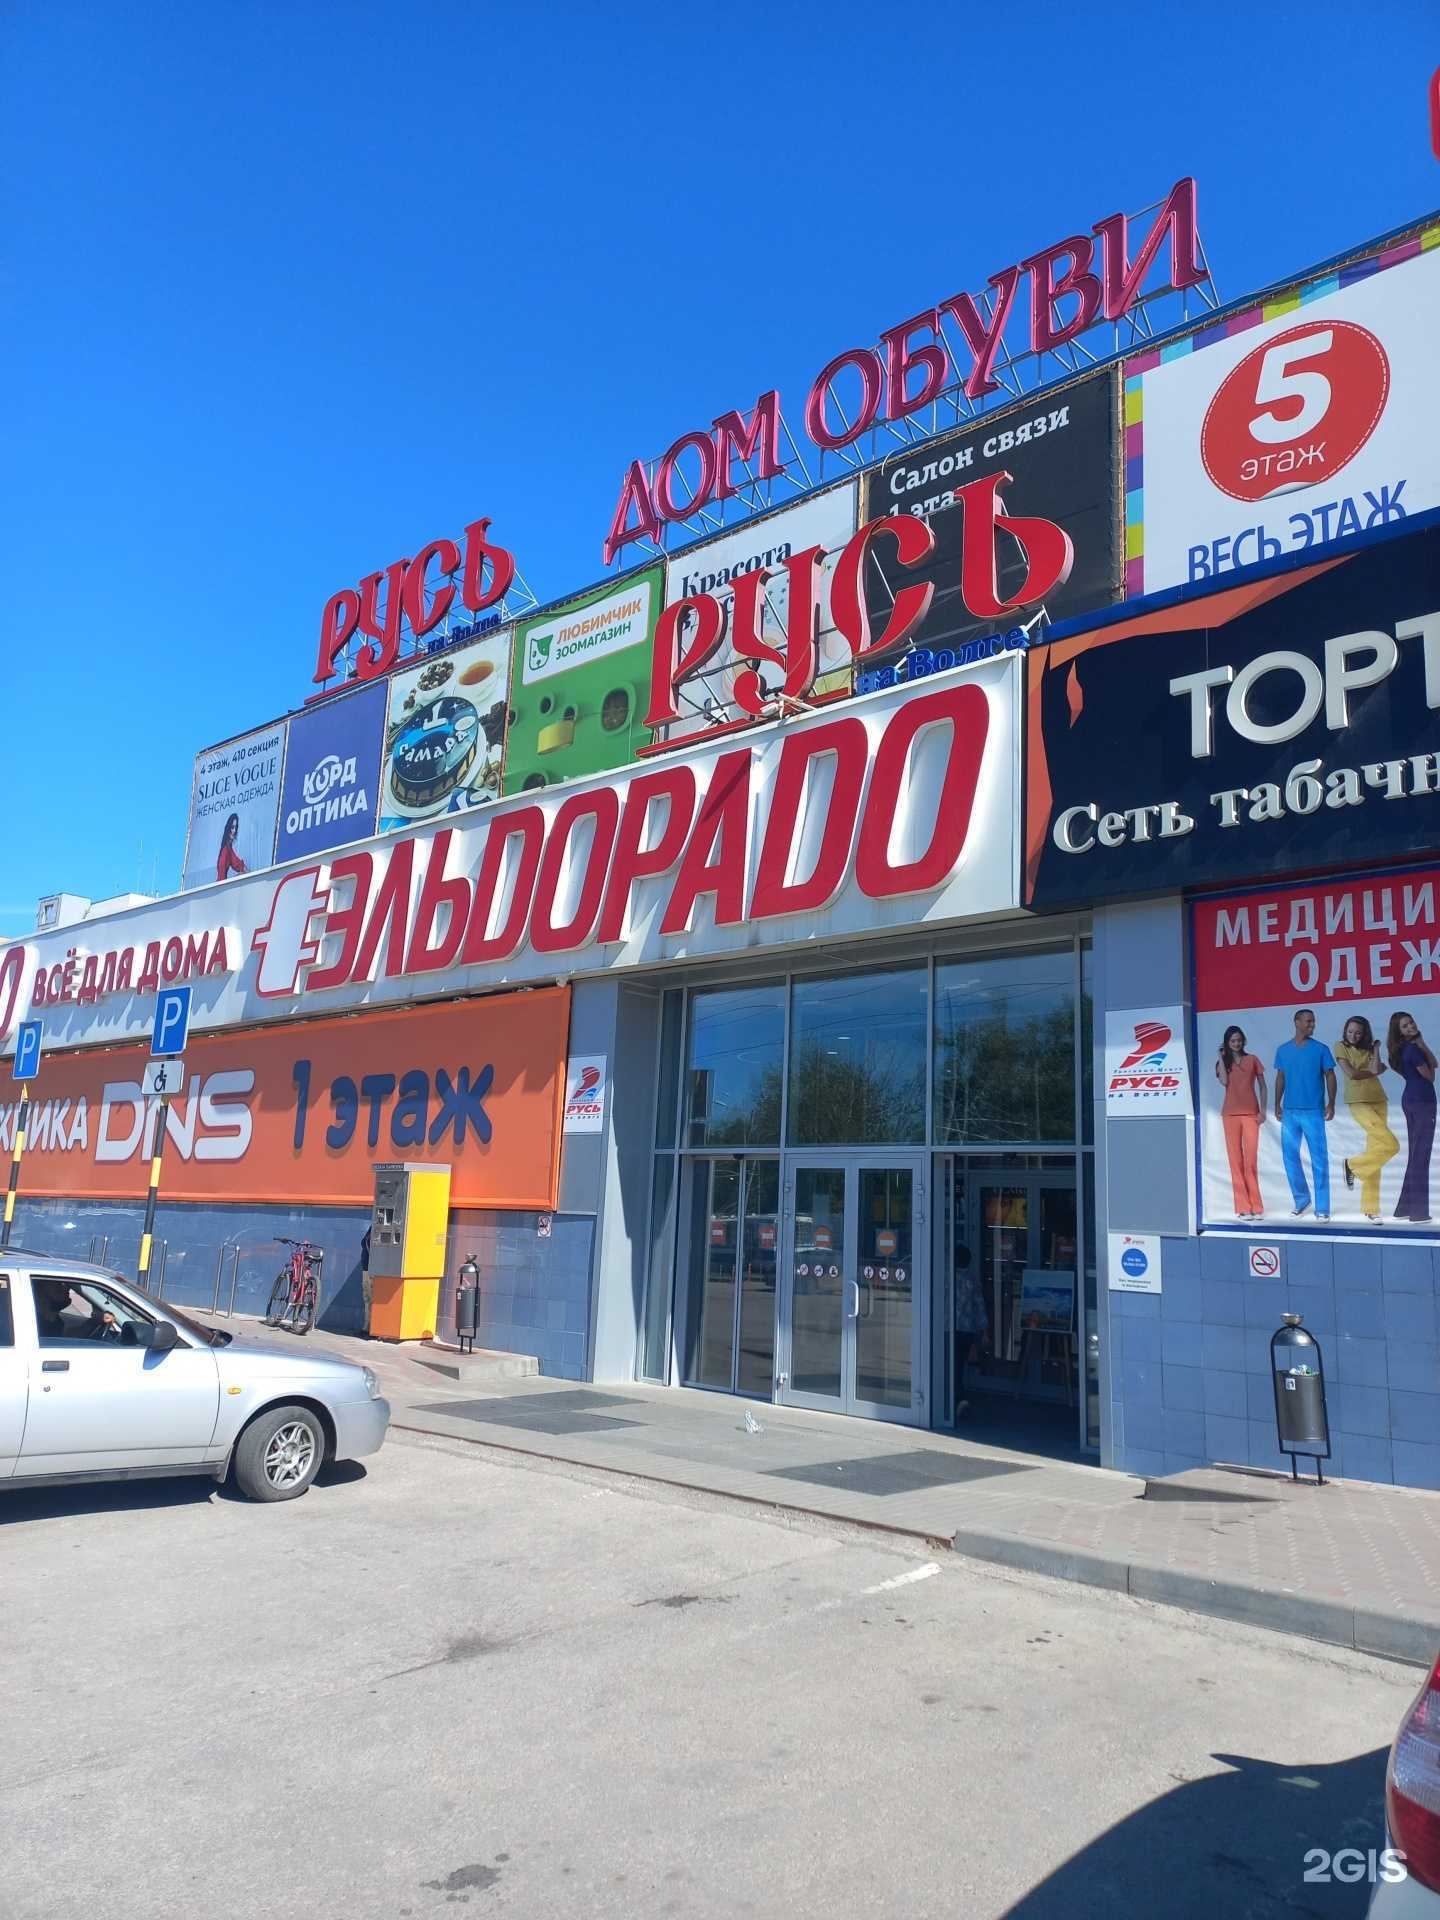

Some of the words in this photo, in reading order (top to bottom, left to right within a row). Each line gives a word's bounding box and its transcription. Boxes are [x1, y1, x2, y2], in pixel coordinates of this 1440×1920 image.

[604, 390, 787, 566] ДОМ
[804, 176, 1208, 450] ОБУВИ
[1249, 329, 1334, 444] 5
[890, 446, 974, 495] Салон
[982, 406, 1070, 458] связи
[1240, 441, 1327, 482] этаж
[911, 490, 960, 520] эта
[1188, 525, 1282, 584] ВЕСЬ
[1288, 479, 1408, 550] ЭТАЖ
[681, 542, 792, 599] Красота
[555, 621, 632, 661] ЗООМАГАЗИН
[557, 598, 641, 645] ЛЮБИМЧИК
[857, 666, 897, 697] на
[905, 624, 1030, 681] Волге
[232, 748, 246, 762] 410
[247, 736, 280, 757] секция
[195, 798, 236, 818] ЖЕНСКАЯ
[237, 781, 275, 804] ОДЕЖДА
[197, 775, 231, 804] SLICE
[234, 757, 277, 787] VOGUE
[303, 755, 356, 804] КОРД
[286, 788, 368, 834] ОПТИКА
[1052, 801, 1194, 854] Сеть
[32, 948, 76, 1007] ВСЁ
[77, 947, 135, 1005] ДЛЯ
[137, 926, 227, 994] ДОМА
[160, 996, 183, 1048] P
[293, 1060, 311, 1149] 1
[326, 1063, 494, 1149] этаж
[1110, 1076, 1180, 1089] РУСЬ
[95, 1070, 255, 1162] DNS
[567, 1105, 602, 1113] РУСЬ
